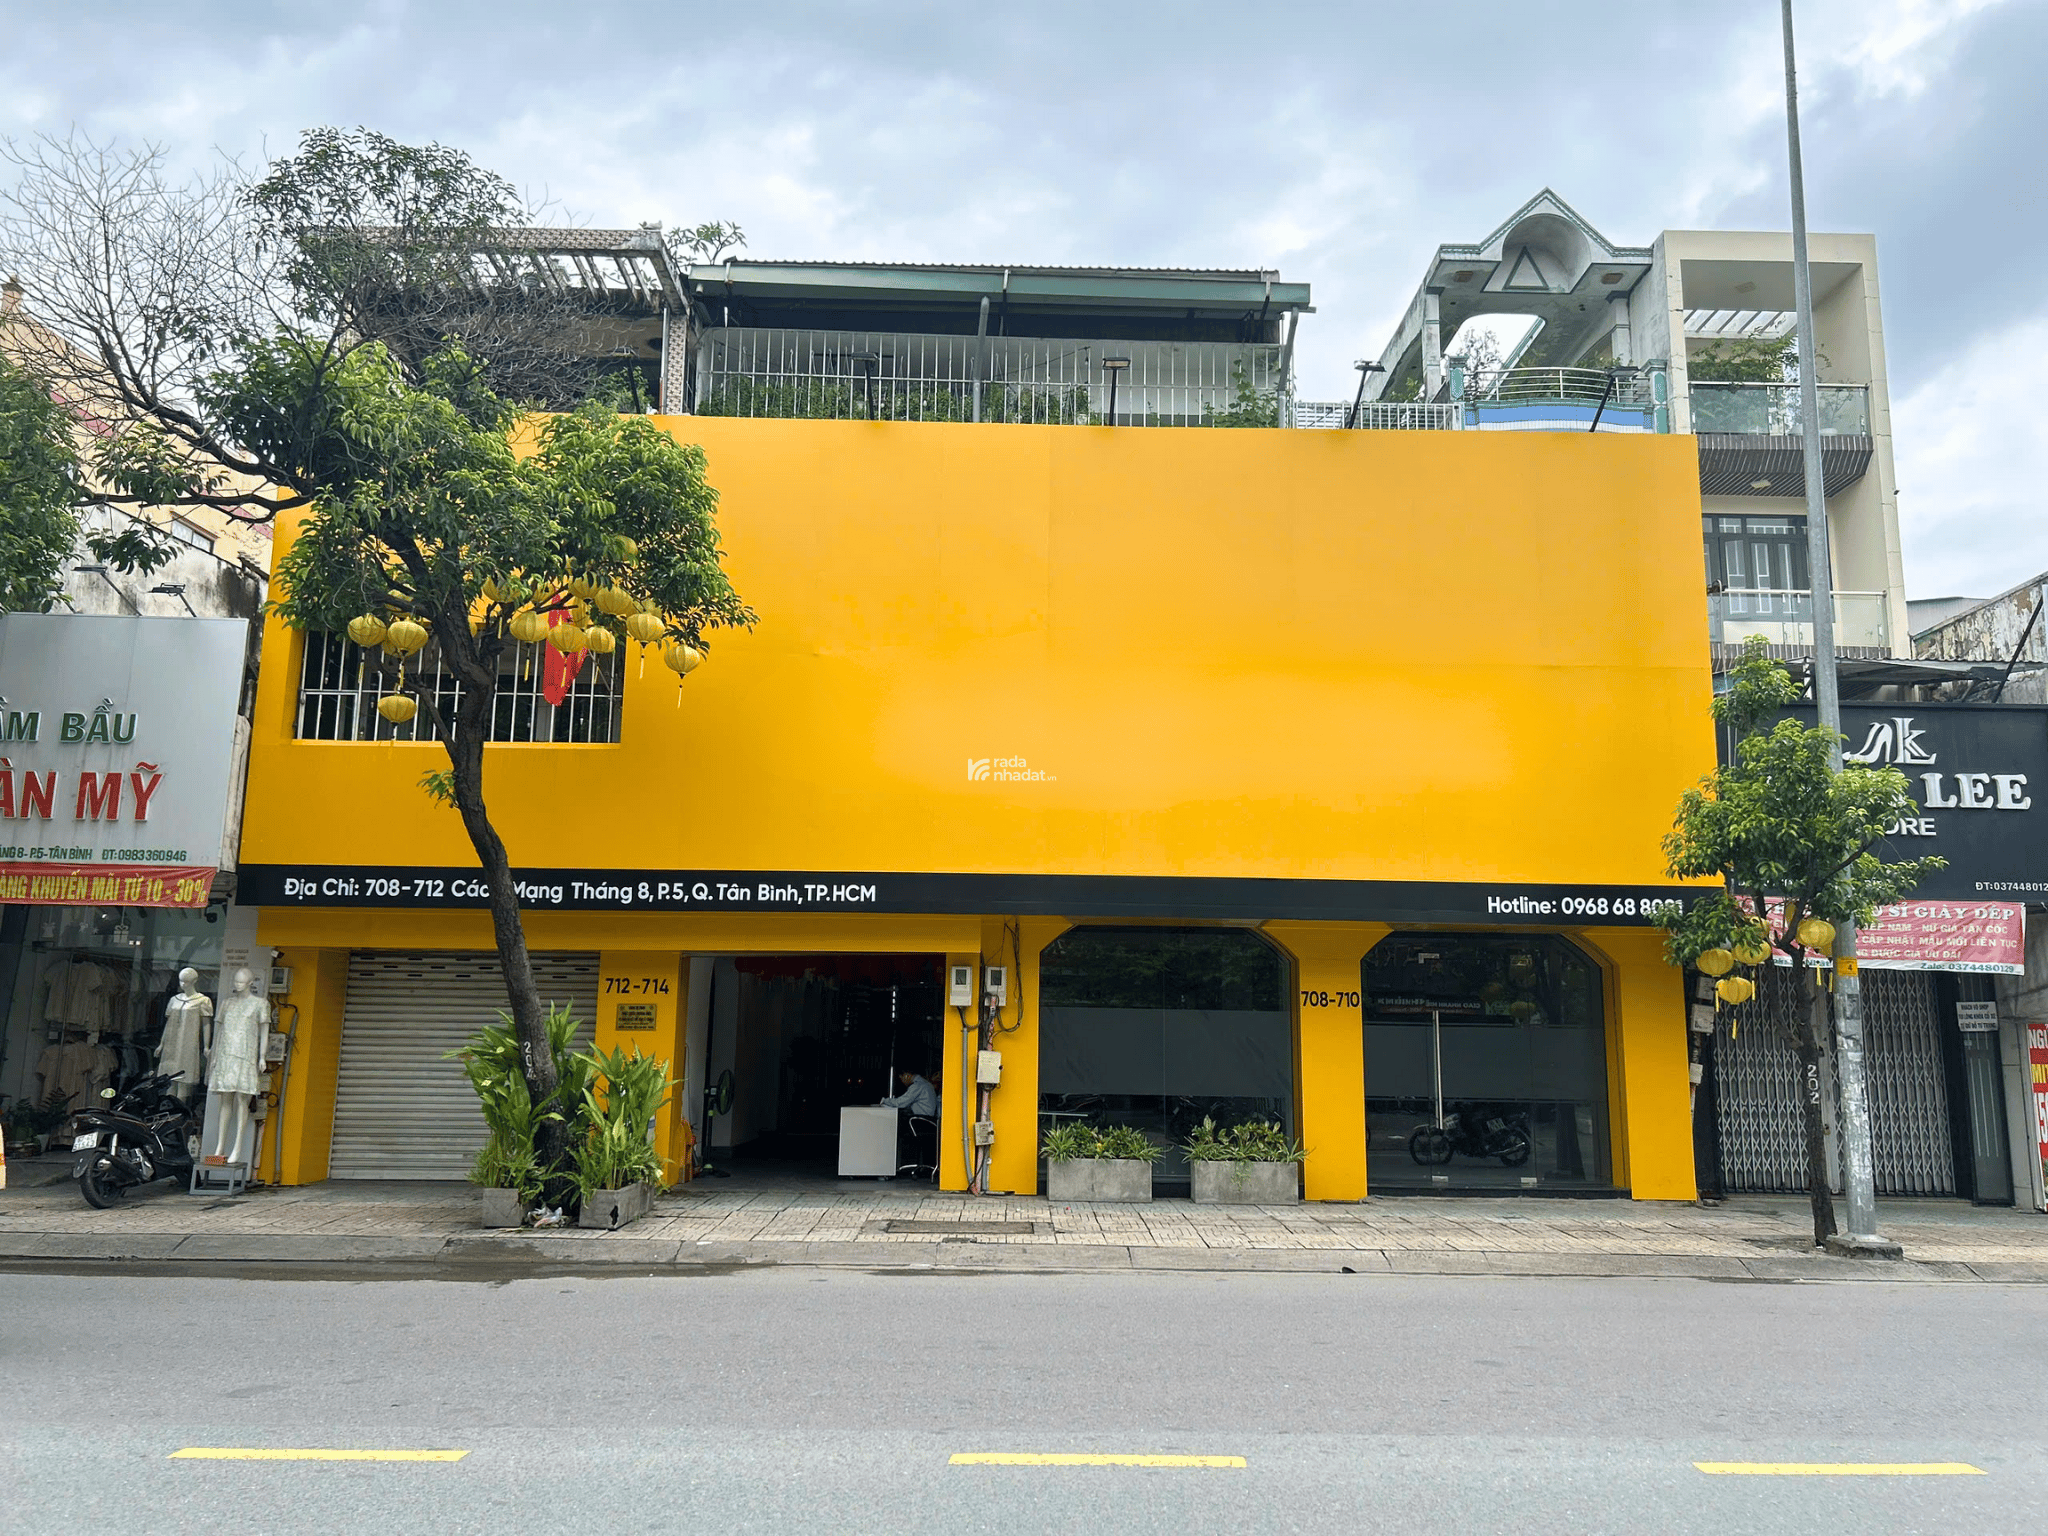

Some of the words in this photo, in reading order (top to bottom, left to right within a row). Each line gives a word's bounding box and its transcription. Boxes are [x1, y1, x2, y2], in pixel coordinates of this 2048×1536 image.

[60, 698, 138, 743] BẦU
[76, 761, 164, 822] MỸ
[1919, 773, 2031, 810] LEE
[31, 869, 89, 900] KHUYẾN
[146, 879, 164, 902] 10
[175, 879, 207, 904] 30%
[284, 878, 317, 900] Địa
[322, 878, 359, 897] Chỉ:
[365, 879, 444, 897] 708-712
[451, 879, 490, 898] Các
[513, 881, 563, 904] Mạng
[571, 881, 633, 905] Tháng
[715, 884, 751, 901] Tân
[1487, 896, 1557, 914] Hotline:
[1561, 897, 1609, 916] 0968
[1612, 898, 1636, 916] 68
[1914, 904, 1968, 919] GIÀY
[605, 977, 669, 995] 712-714
[1301, 991, 1360, 1008] 708-710
